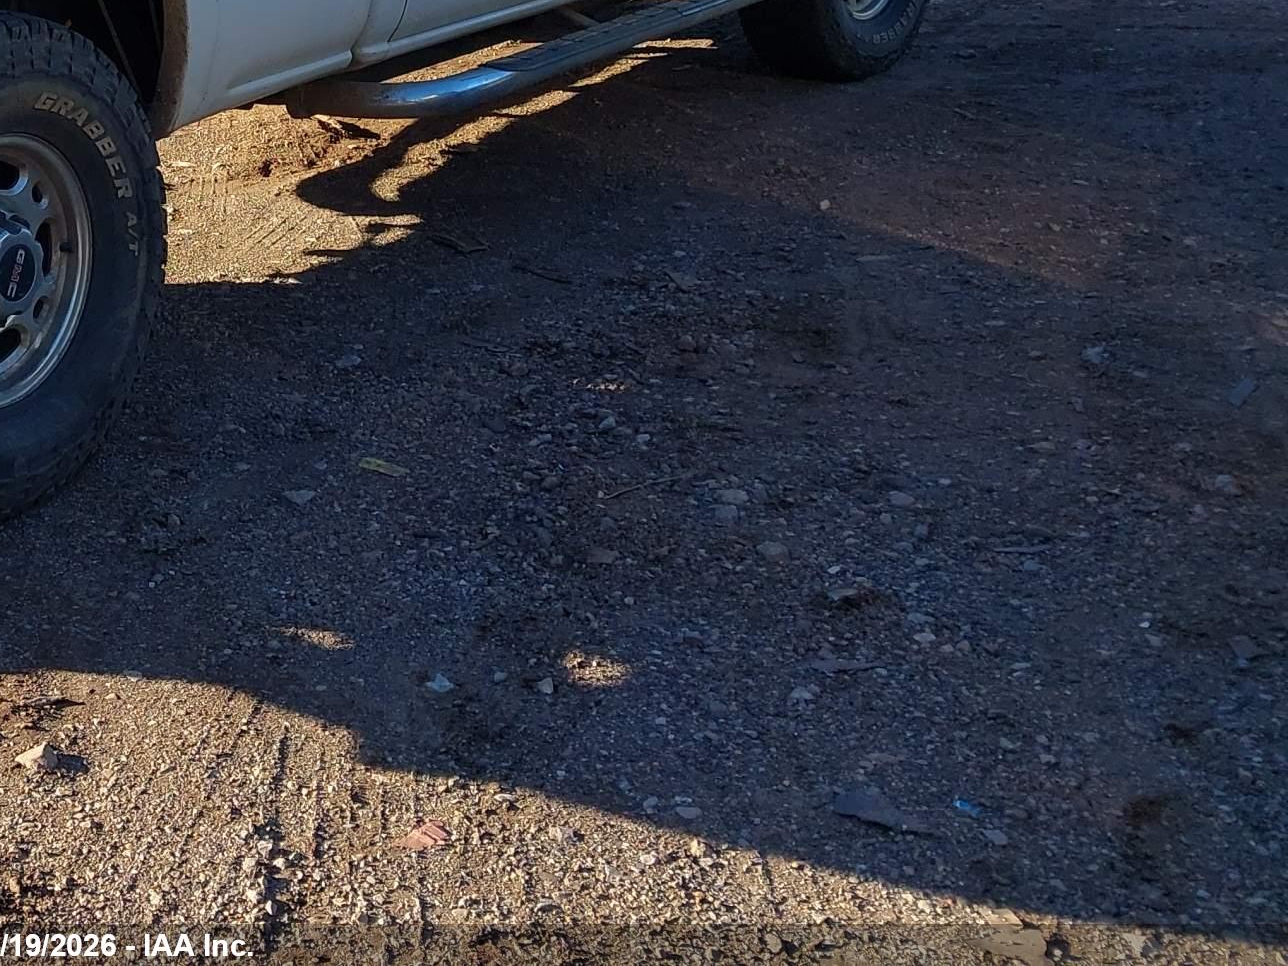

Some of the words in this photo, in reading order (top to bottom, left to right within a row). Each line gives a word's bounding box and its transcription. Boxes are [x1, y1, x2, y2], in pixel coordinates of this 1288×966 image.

[34, 91, 133, 200] GRABBER
[126, 211, 140, 257] A/T
[7, 248, 26, 298] GMC
